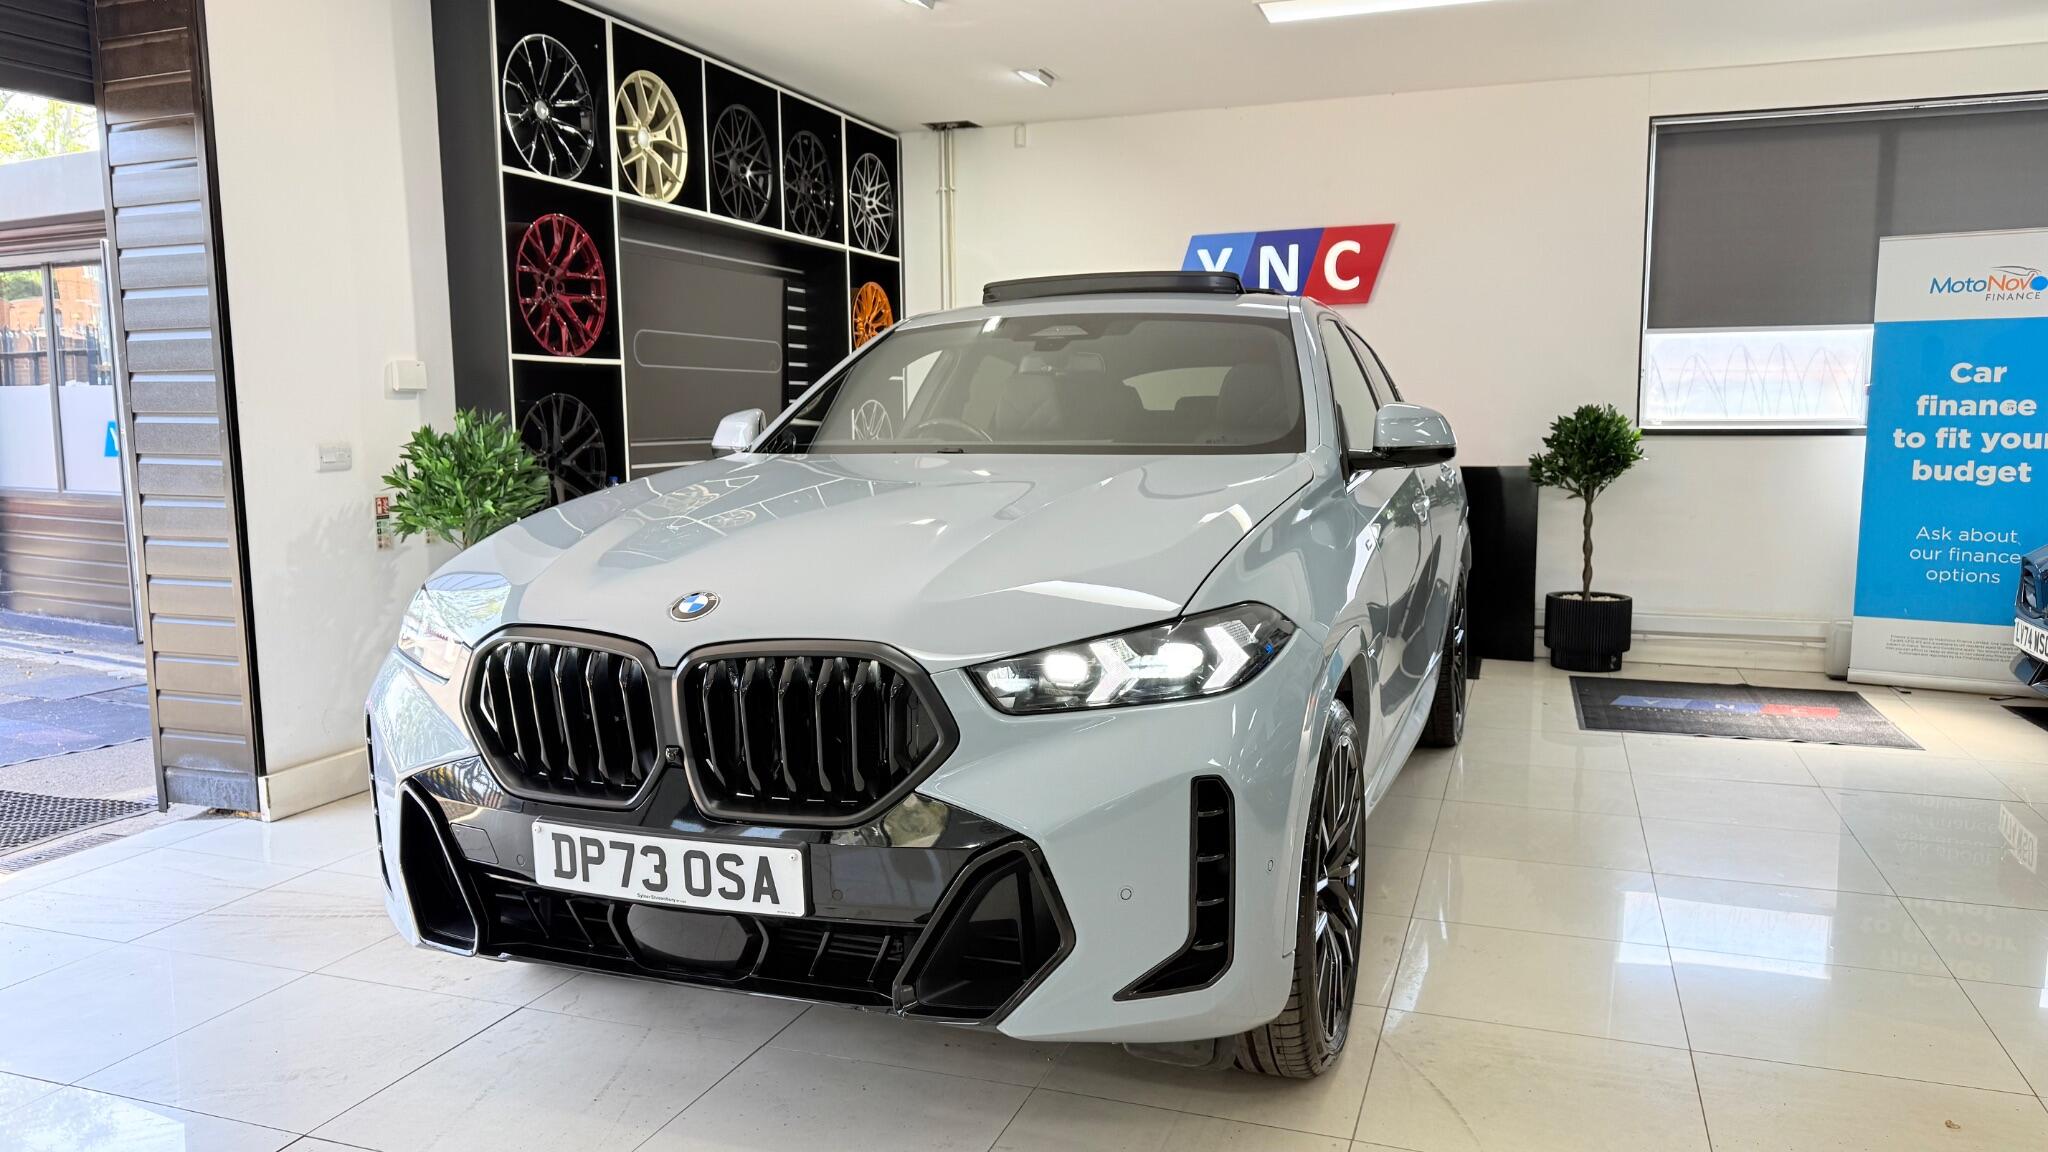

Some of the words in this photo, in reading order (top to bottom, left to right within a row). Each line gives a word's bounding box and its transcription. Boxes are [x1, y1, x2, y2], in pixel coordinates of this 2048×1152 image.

[1985, 292, 2041, 301] FINANCE
[1950, 362, 2008, 384] Car
[1916, 394, 2037, 416] finance
[1893, 428, 1926, 449] to
[1935, 427, 1971, 449] fit
[1912, 459, 2032, 486] budget
[1916, 526, 1952, 541] Ask
[1958, 528, 2019, 543] about
[1909, 548, 1942, 561] our
[1949, 547, 2021, 564] finance
[1925, 568, 2001, 584] options
[552, 832, 668, 892] DP73
[683, 849, 781, 904] OSA
